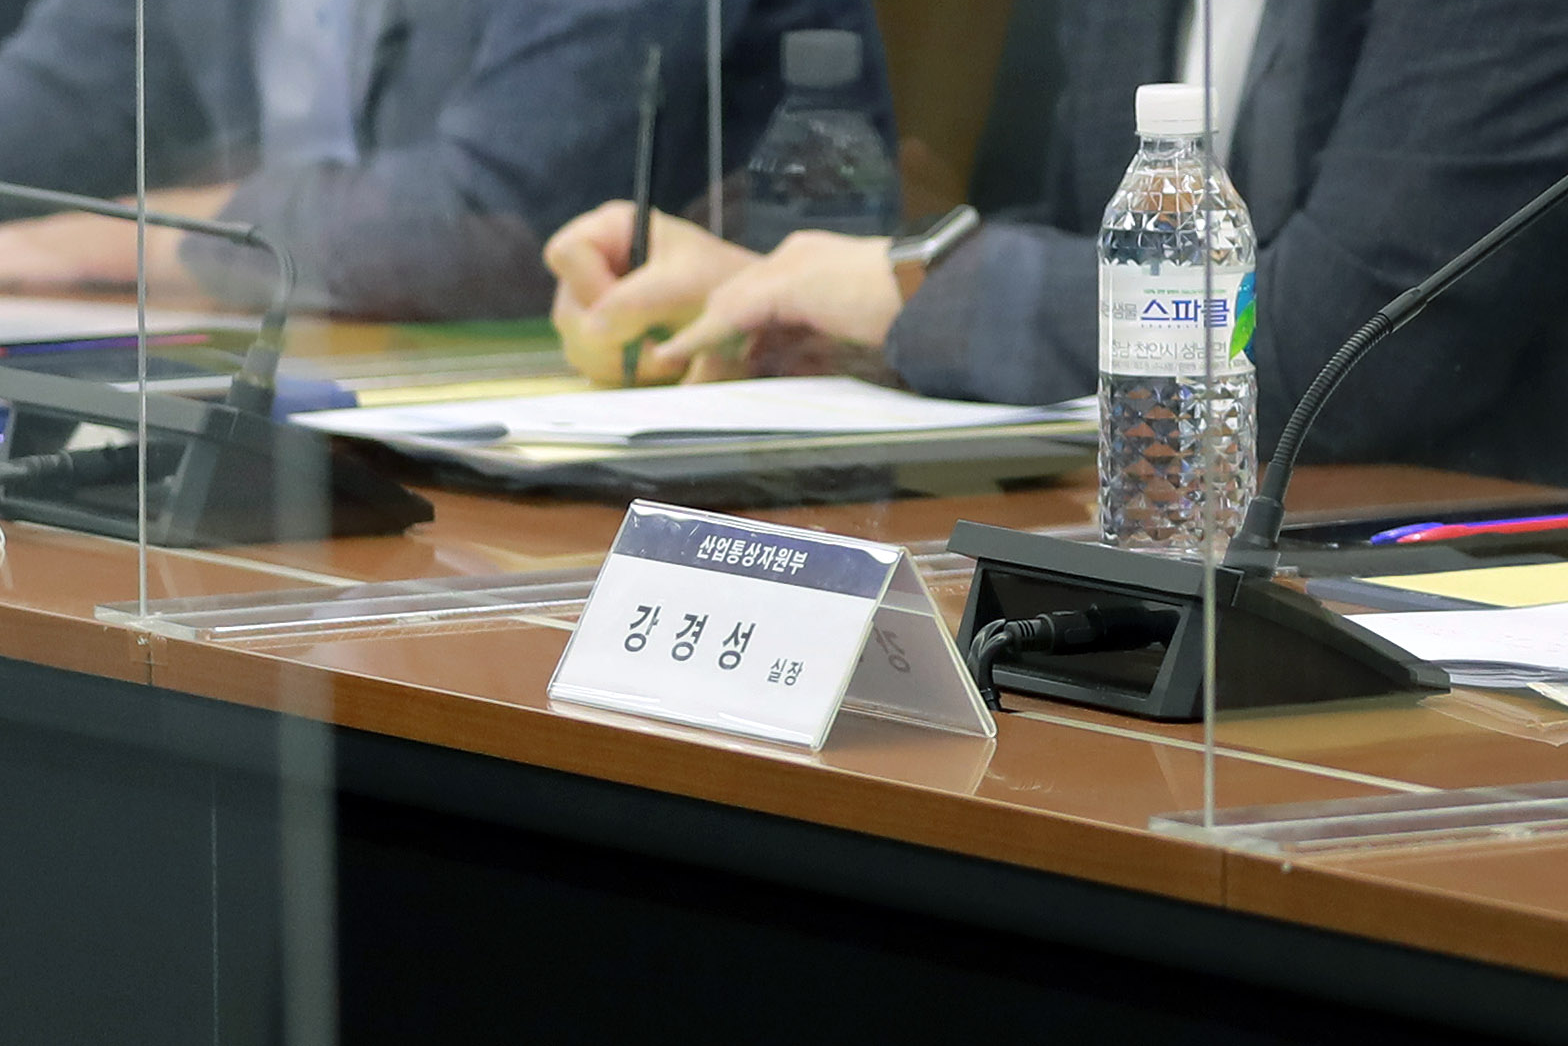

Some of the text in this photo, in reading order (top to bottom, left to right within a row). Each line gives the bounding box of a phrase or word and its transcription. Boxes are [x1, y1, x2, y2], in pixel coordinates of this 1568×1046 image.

[1140, 298, 1230, 328] 스파클
[696, 534, 808, 575] 산업통상자원부
[767, 657, 804, 687] 실장
